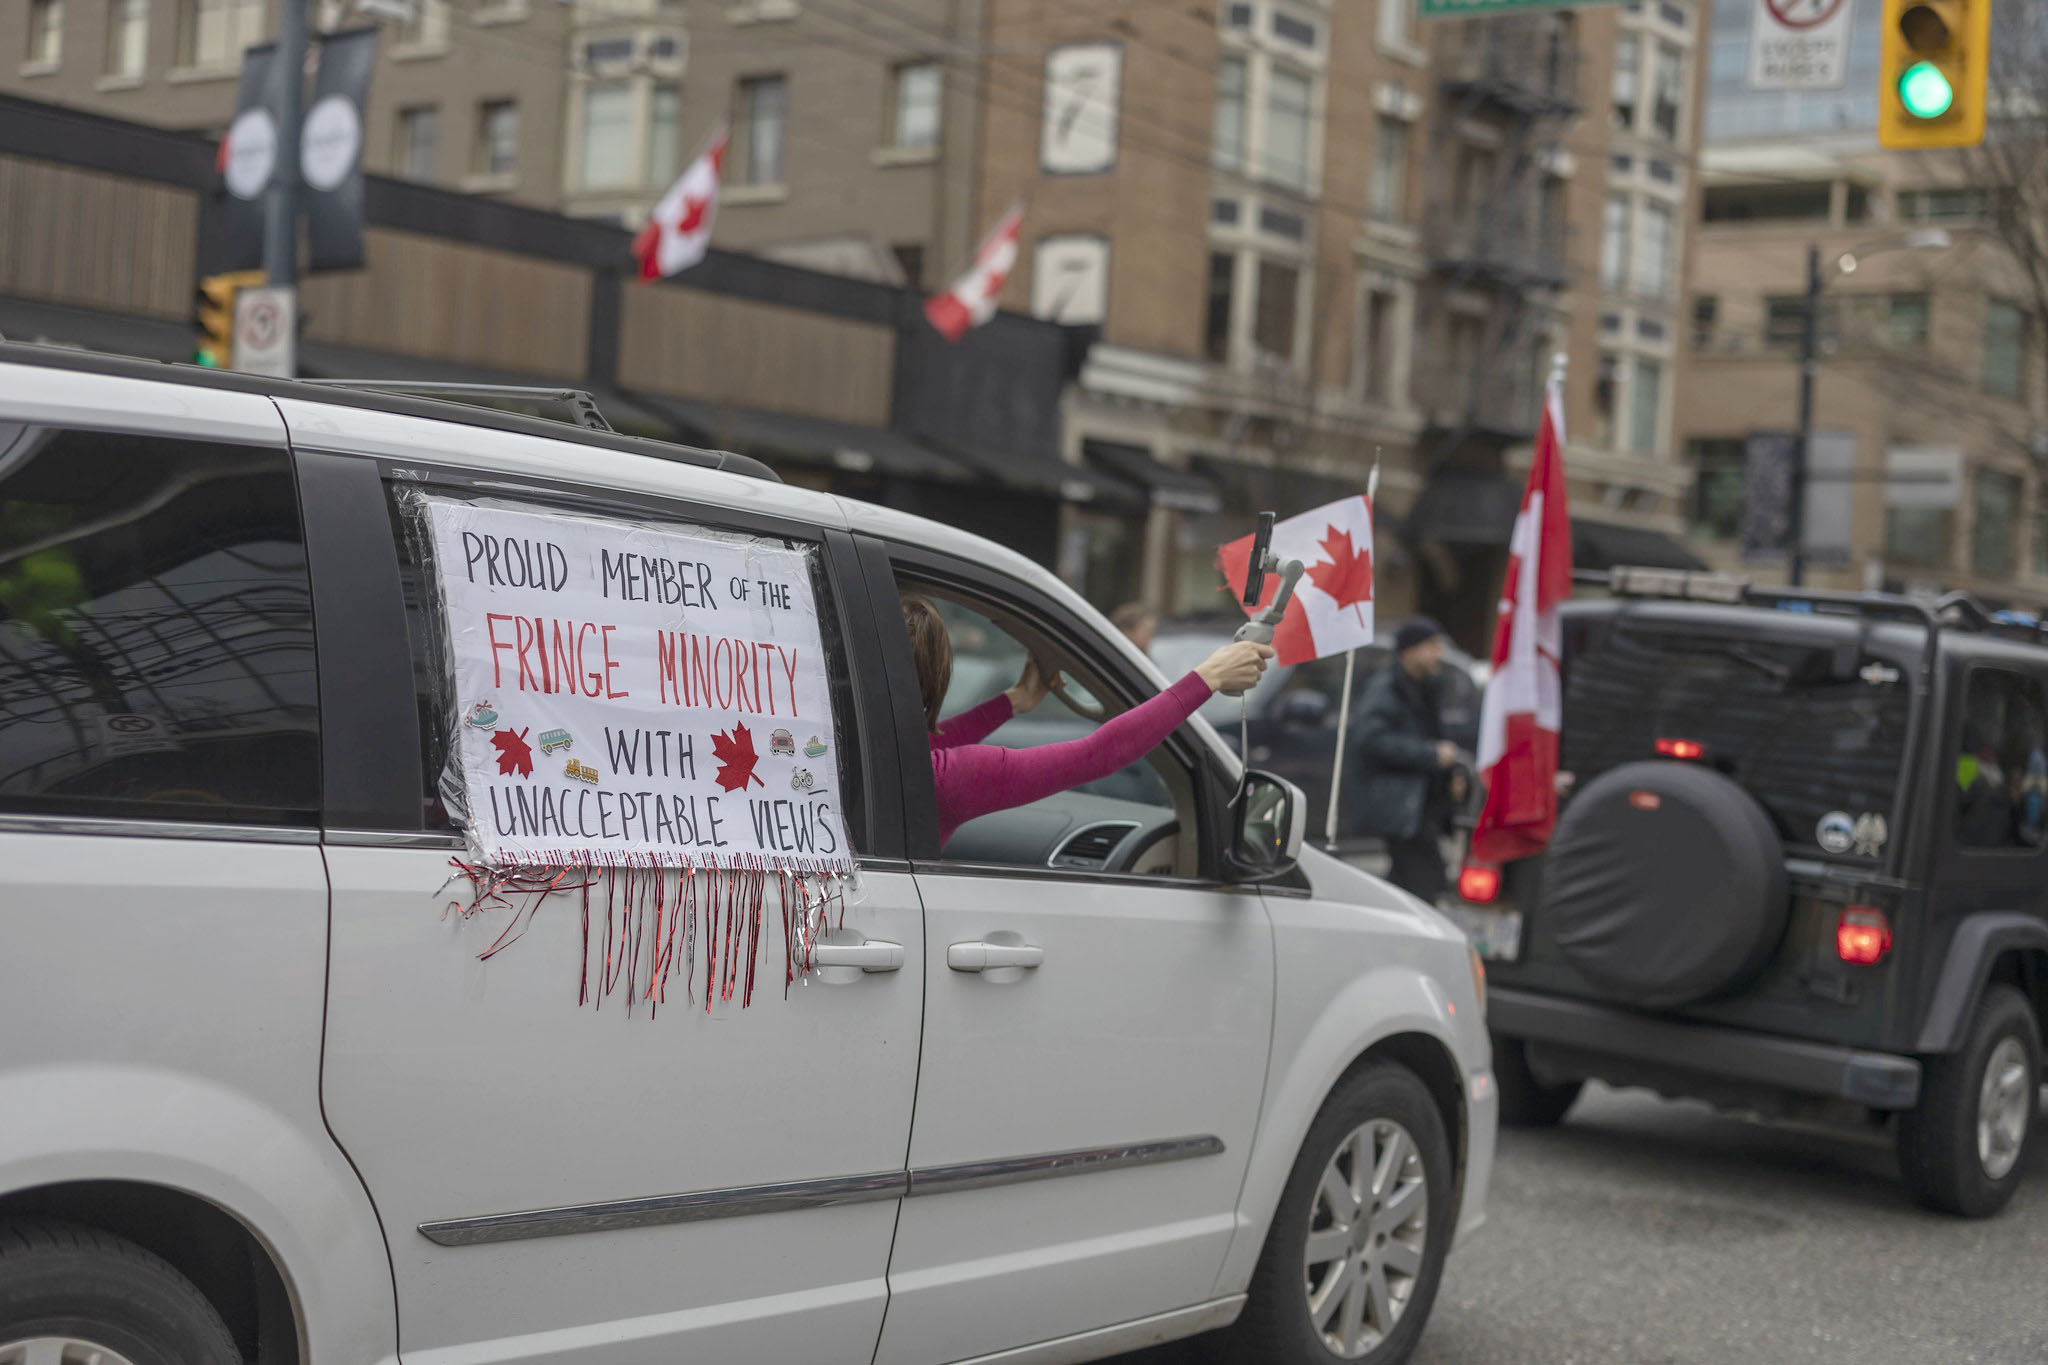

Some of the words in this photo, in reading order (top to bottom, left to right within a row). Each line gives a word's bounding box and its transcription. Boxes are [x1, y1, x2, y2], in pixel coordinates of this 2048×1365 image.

[462, 532, 568, 593] PROUD
[601, 548, 718, 610] MEMBER
[730, 576, 752, 602] OF
[757, 580, 791, 610] THE
[486, 612, 629, 699] FRINGE
[657, 629, 798, 717] MINORITY
[604, 726, 697, 780] WITH
[489, 785, 729, 847] UNACCEPTABLE
[749, 789, 837, 854] VIEWS
